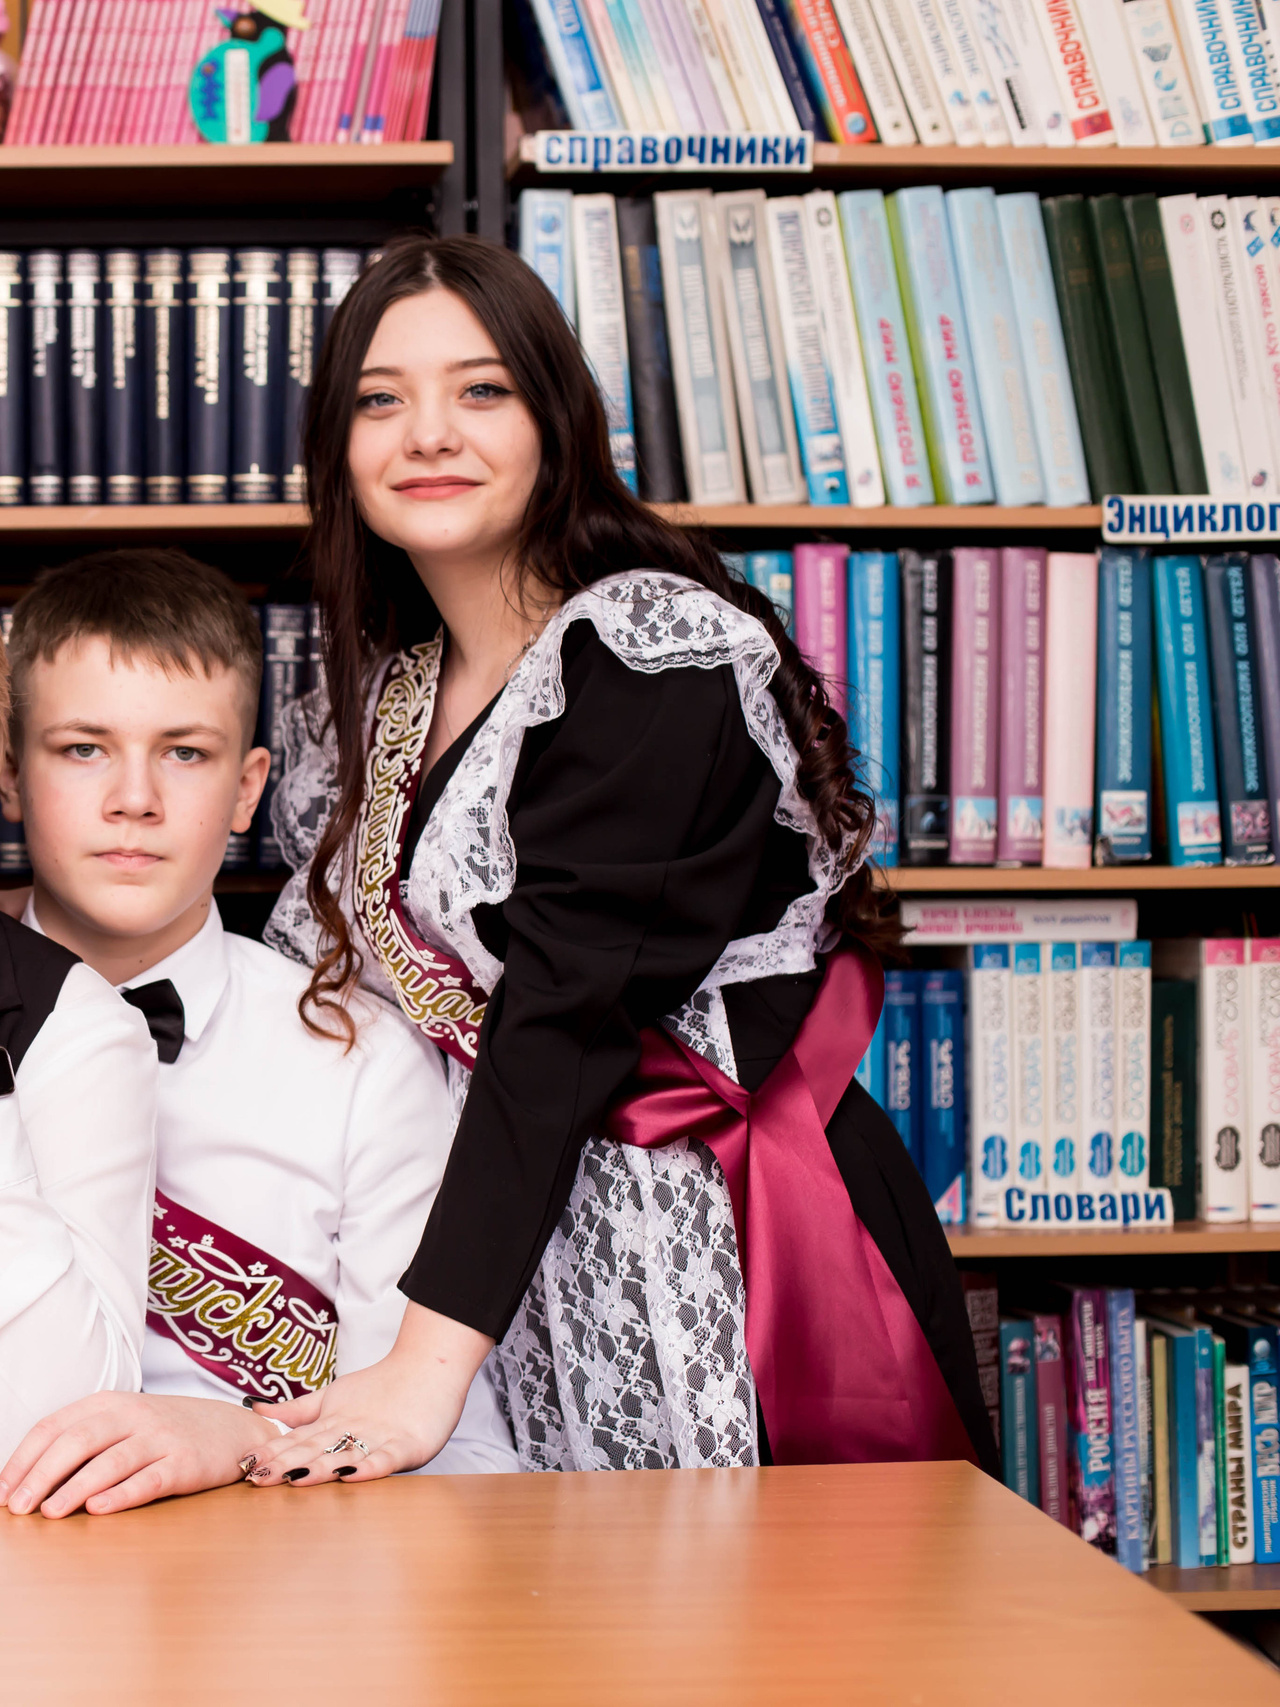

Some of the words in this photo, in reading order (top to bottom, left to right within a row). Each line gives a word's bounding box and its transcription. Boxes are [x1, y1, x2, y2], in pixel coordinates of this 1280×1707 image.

[1004, 1187, 1166, 1225] Словари
[1226, 1382, 1243, 1450] МИРА
[1228, 1455, 1247, 1550] СТРАНЫ
